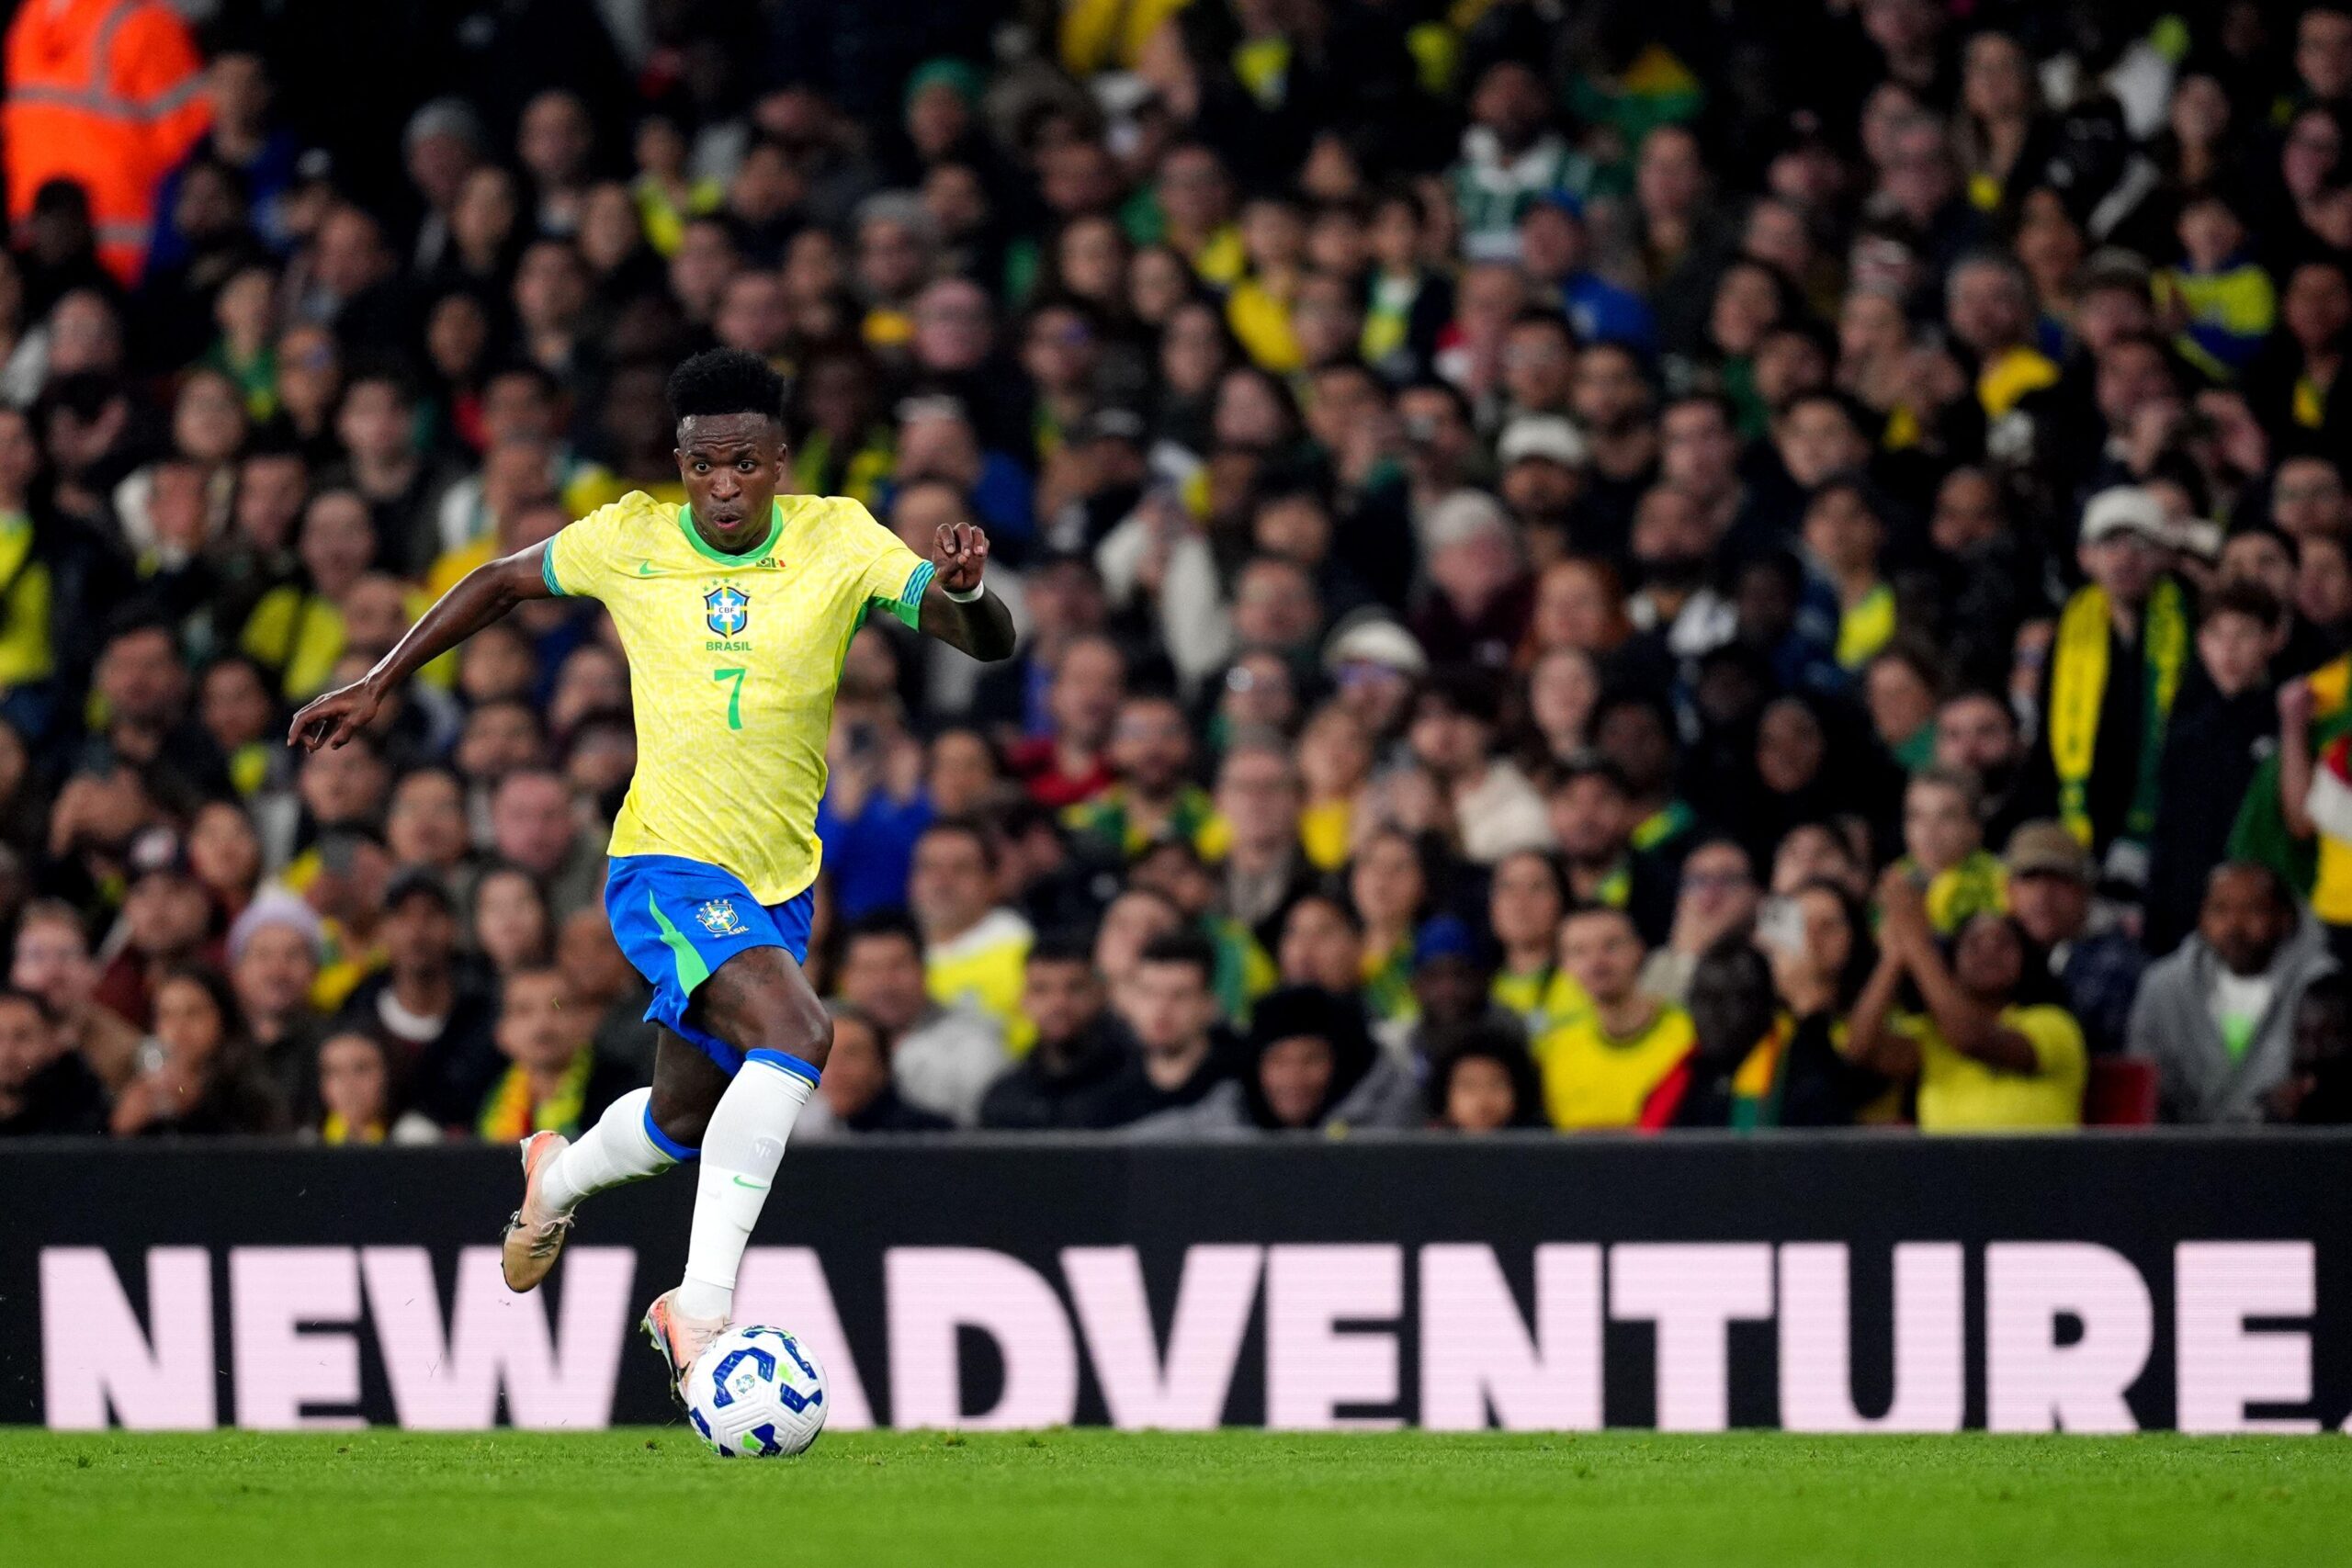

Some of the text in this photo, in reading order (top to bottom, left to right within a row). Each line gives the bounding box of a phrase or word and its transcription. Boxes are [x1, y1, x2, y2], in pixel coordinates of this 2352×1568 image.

[706, 641, 752, 651] BRASIL
[714, 668, 746, 730] 7
[39, 1246, 636, 1430] NEW
